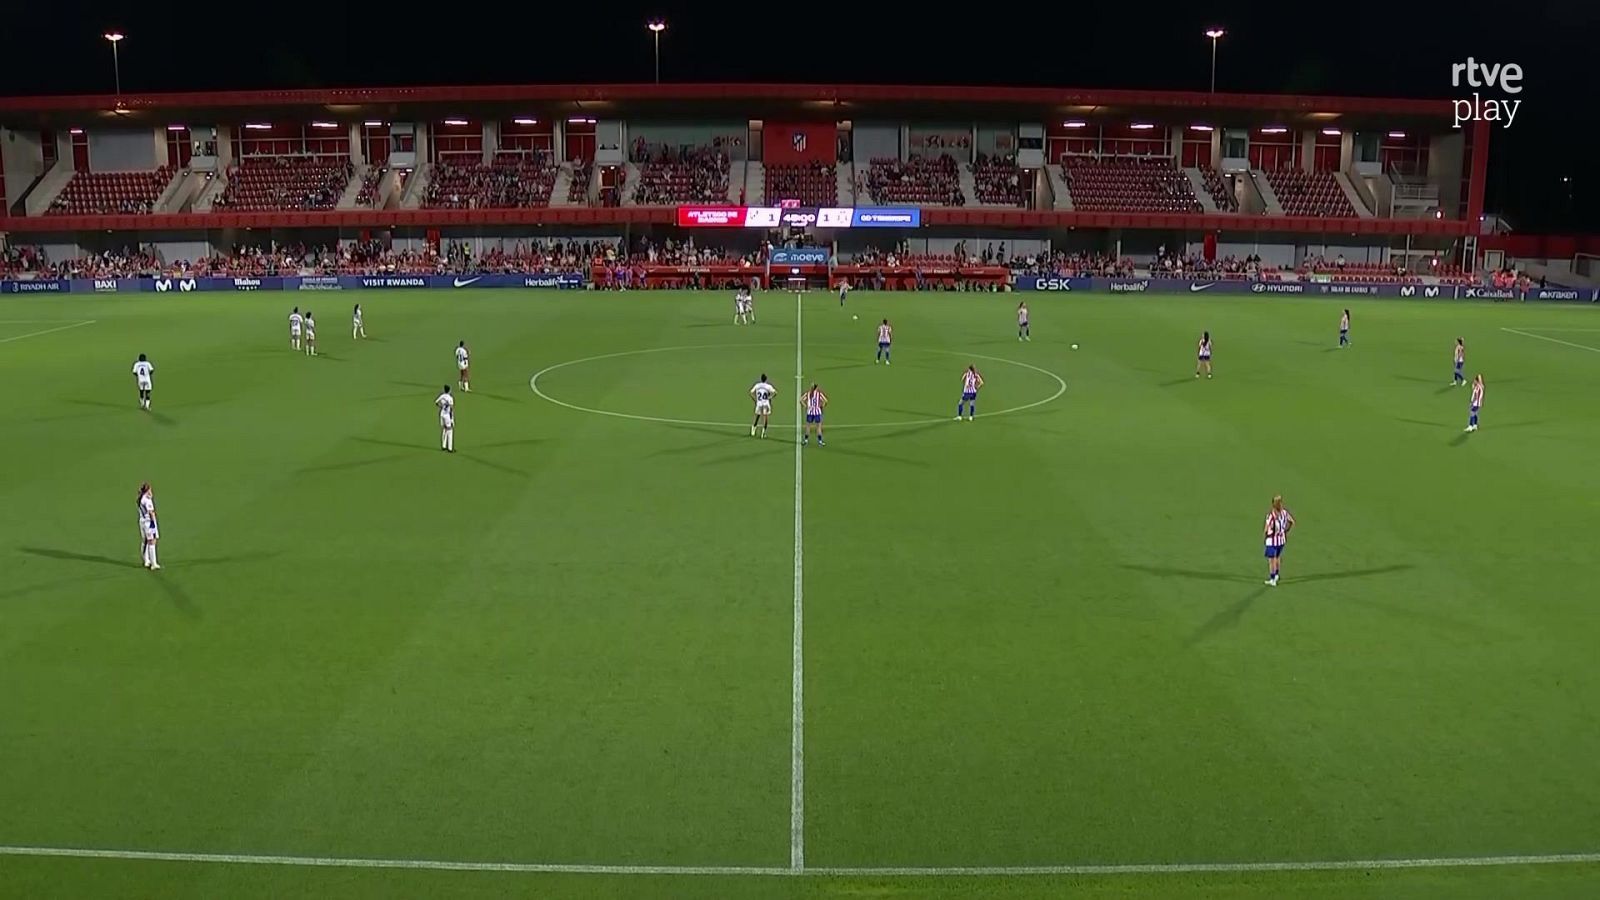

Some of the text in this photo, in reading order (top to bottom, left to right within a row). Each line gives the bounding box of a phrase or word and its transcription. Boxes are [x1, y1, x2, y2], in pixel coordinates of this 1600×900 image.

[790, 253, 824, 261] moeve
[94, 280, 117, 289] BAXI
[362, 278, 425, 287] VISIT RWANDA
[1035, 279, 1071, 291] GSK
[1110, 281, 1146, 292] Herbalife
[1266, 285, 1303, 293] HYUNDAI
[1476, 288, 1514, 298] CaixaBank
